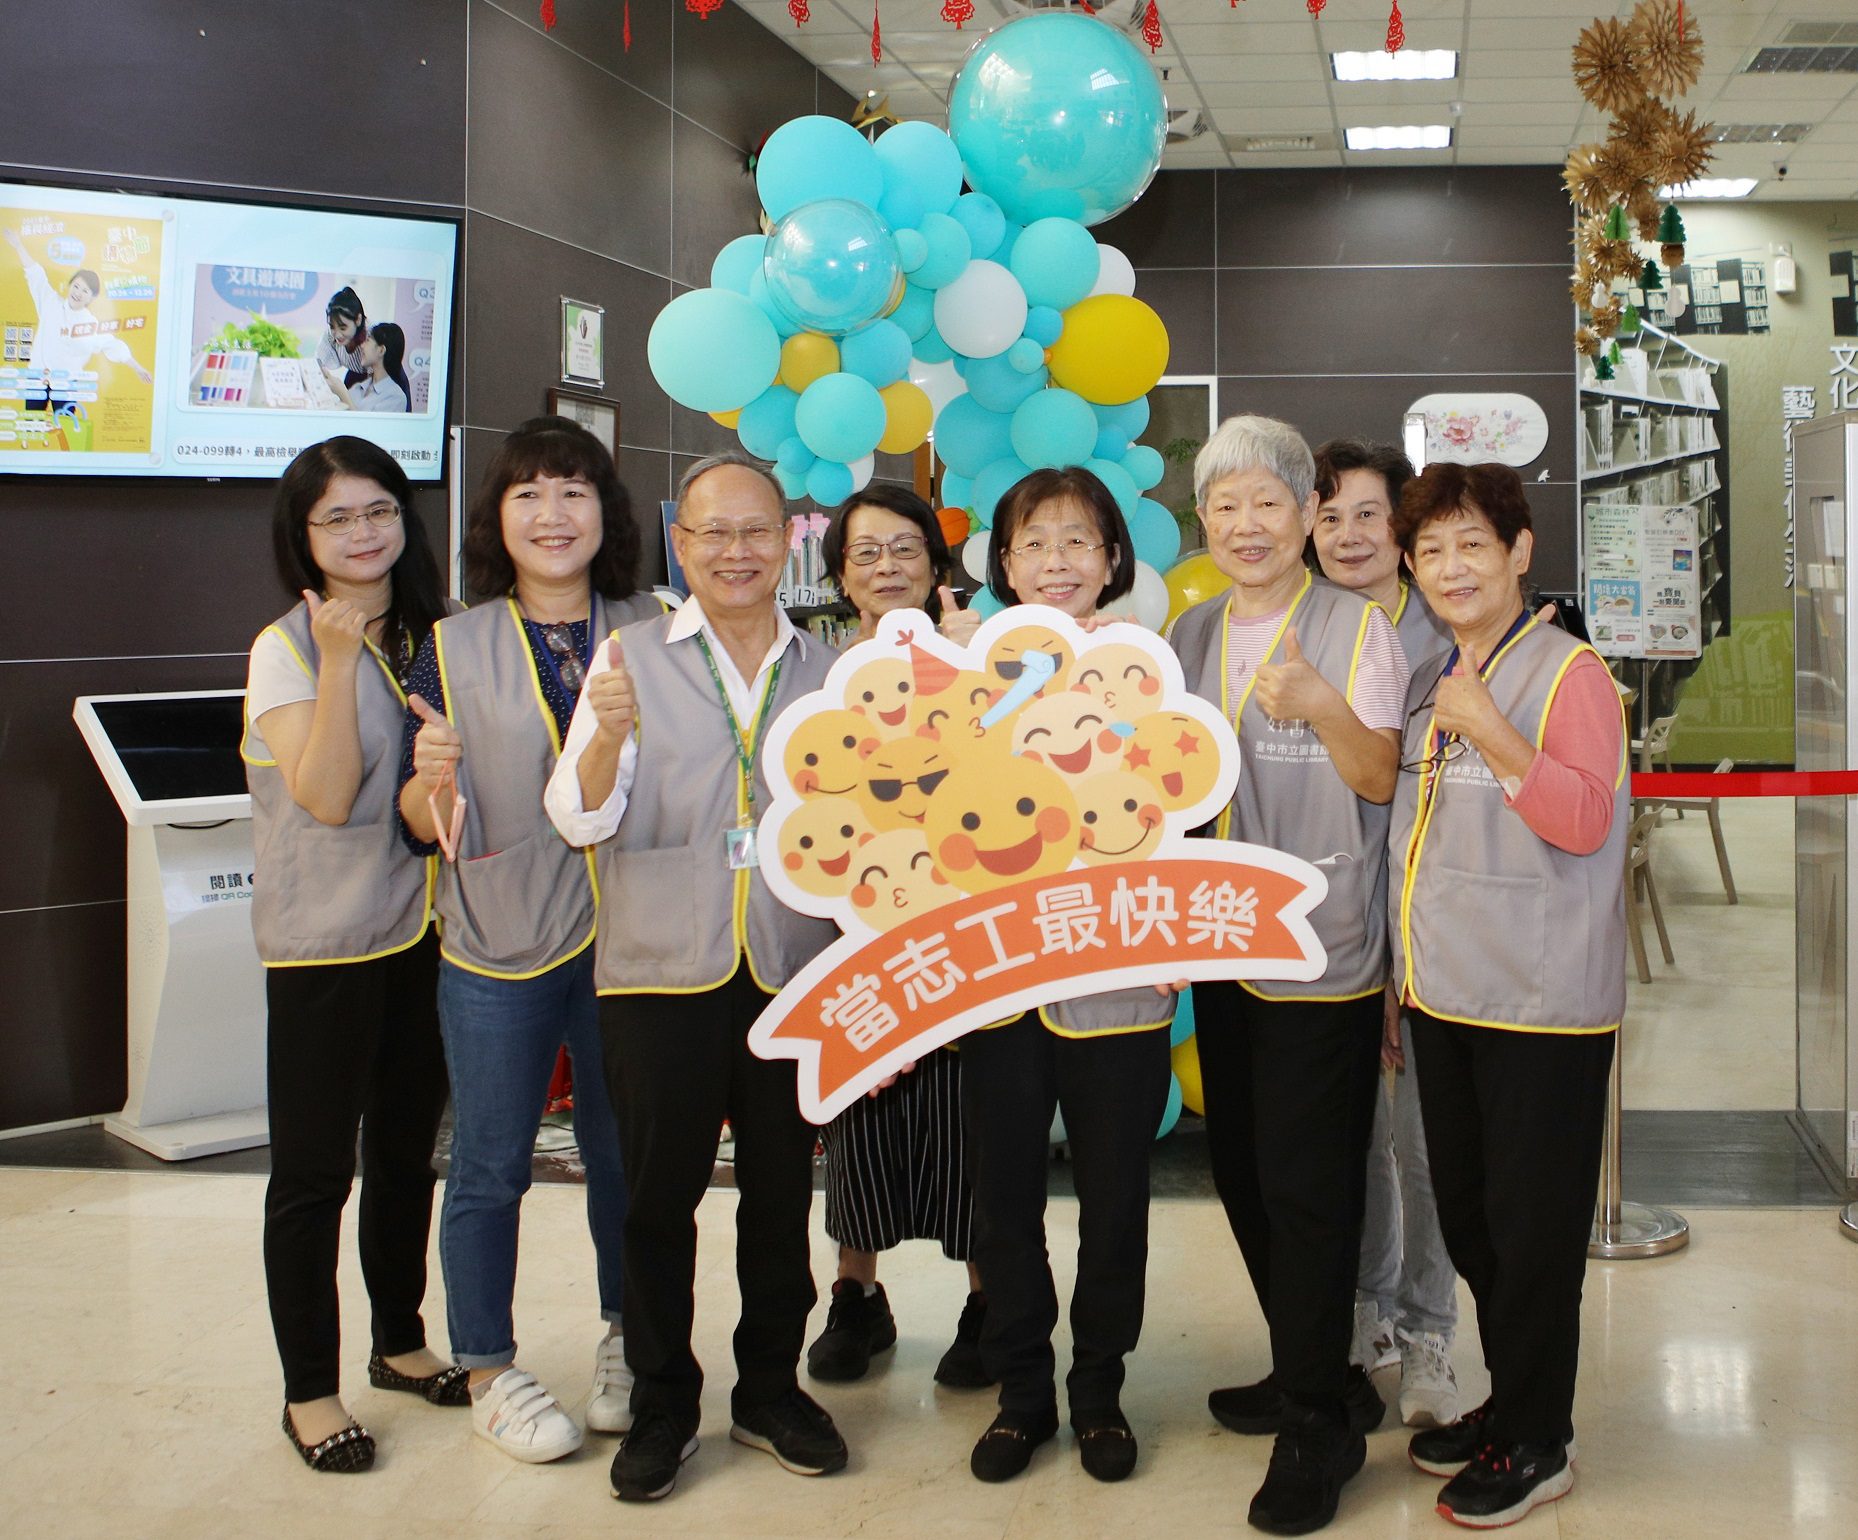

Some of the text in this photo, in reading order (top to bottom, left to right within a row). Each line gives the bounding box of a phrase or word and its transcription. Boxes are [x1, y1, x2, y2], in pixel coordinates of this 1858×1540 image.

[1445, 765, 1495, 779] 臺中市立圖
[819, 876, 1260, 1052] 當志工最快樂
